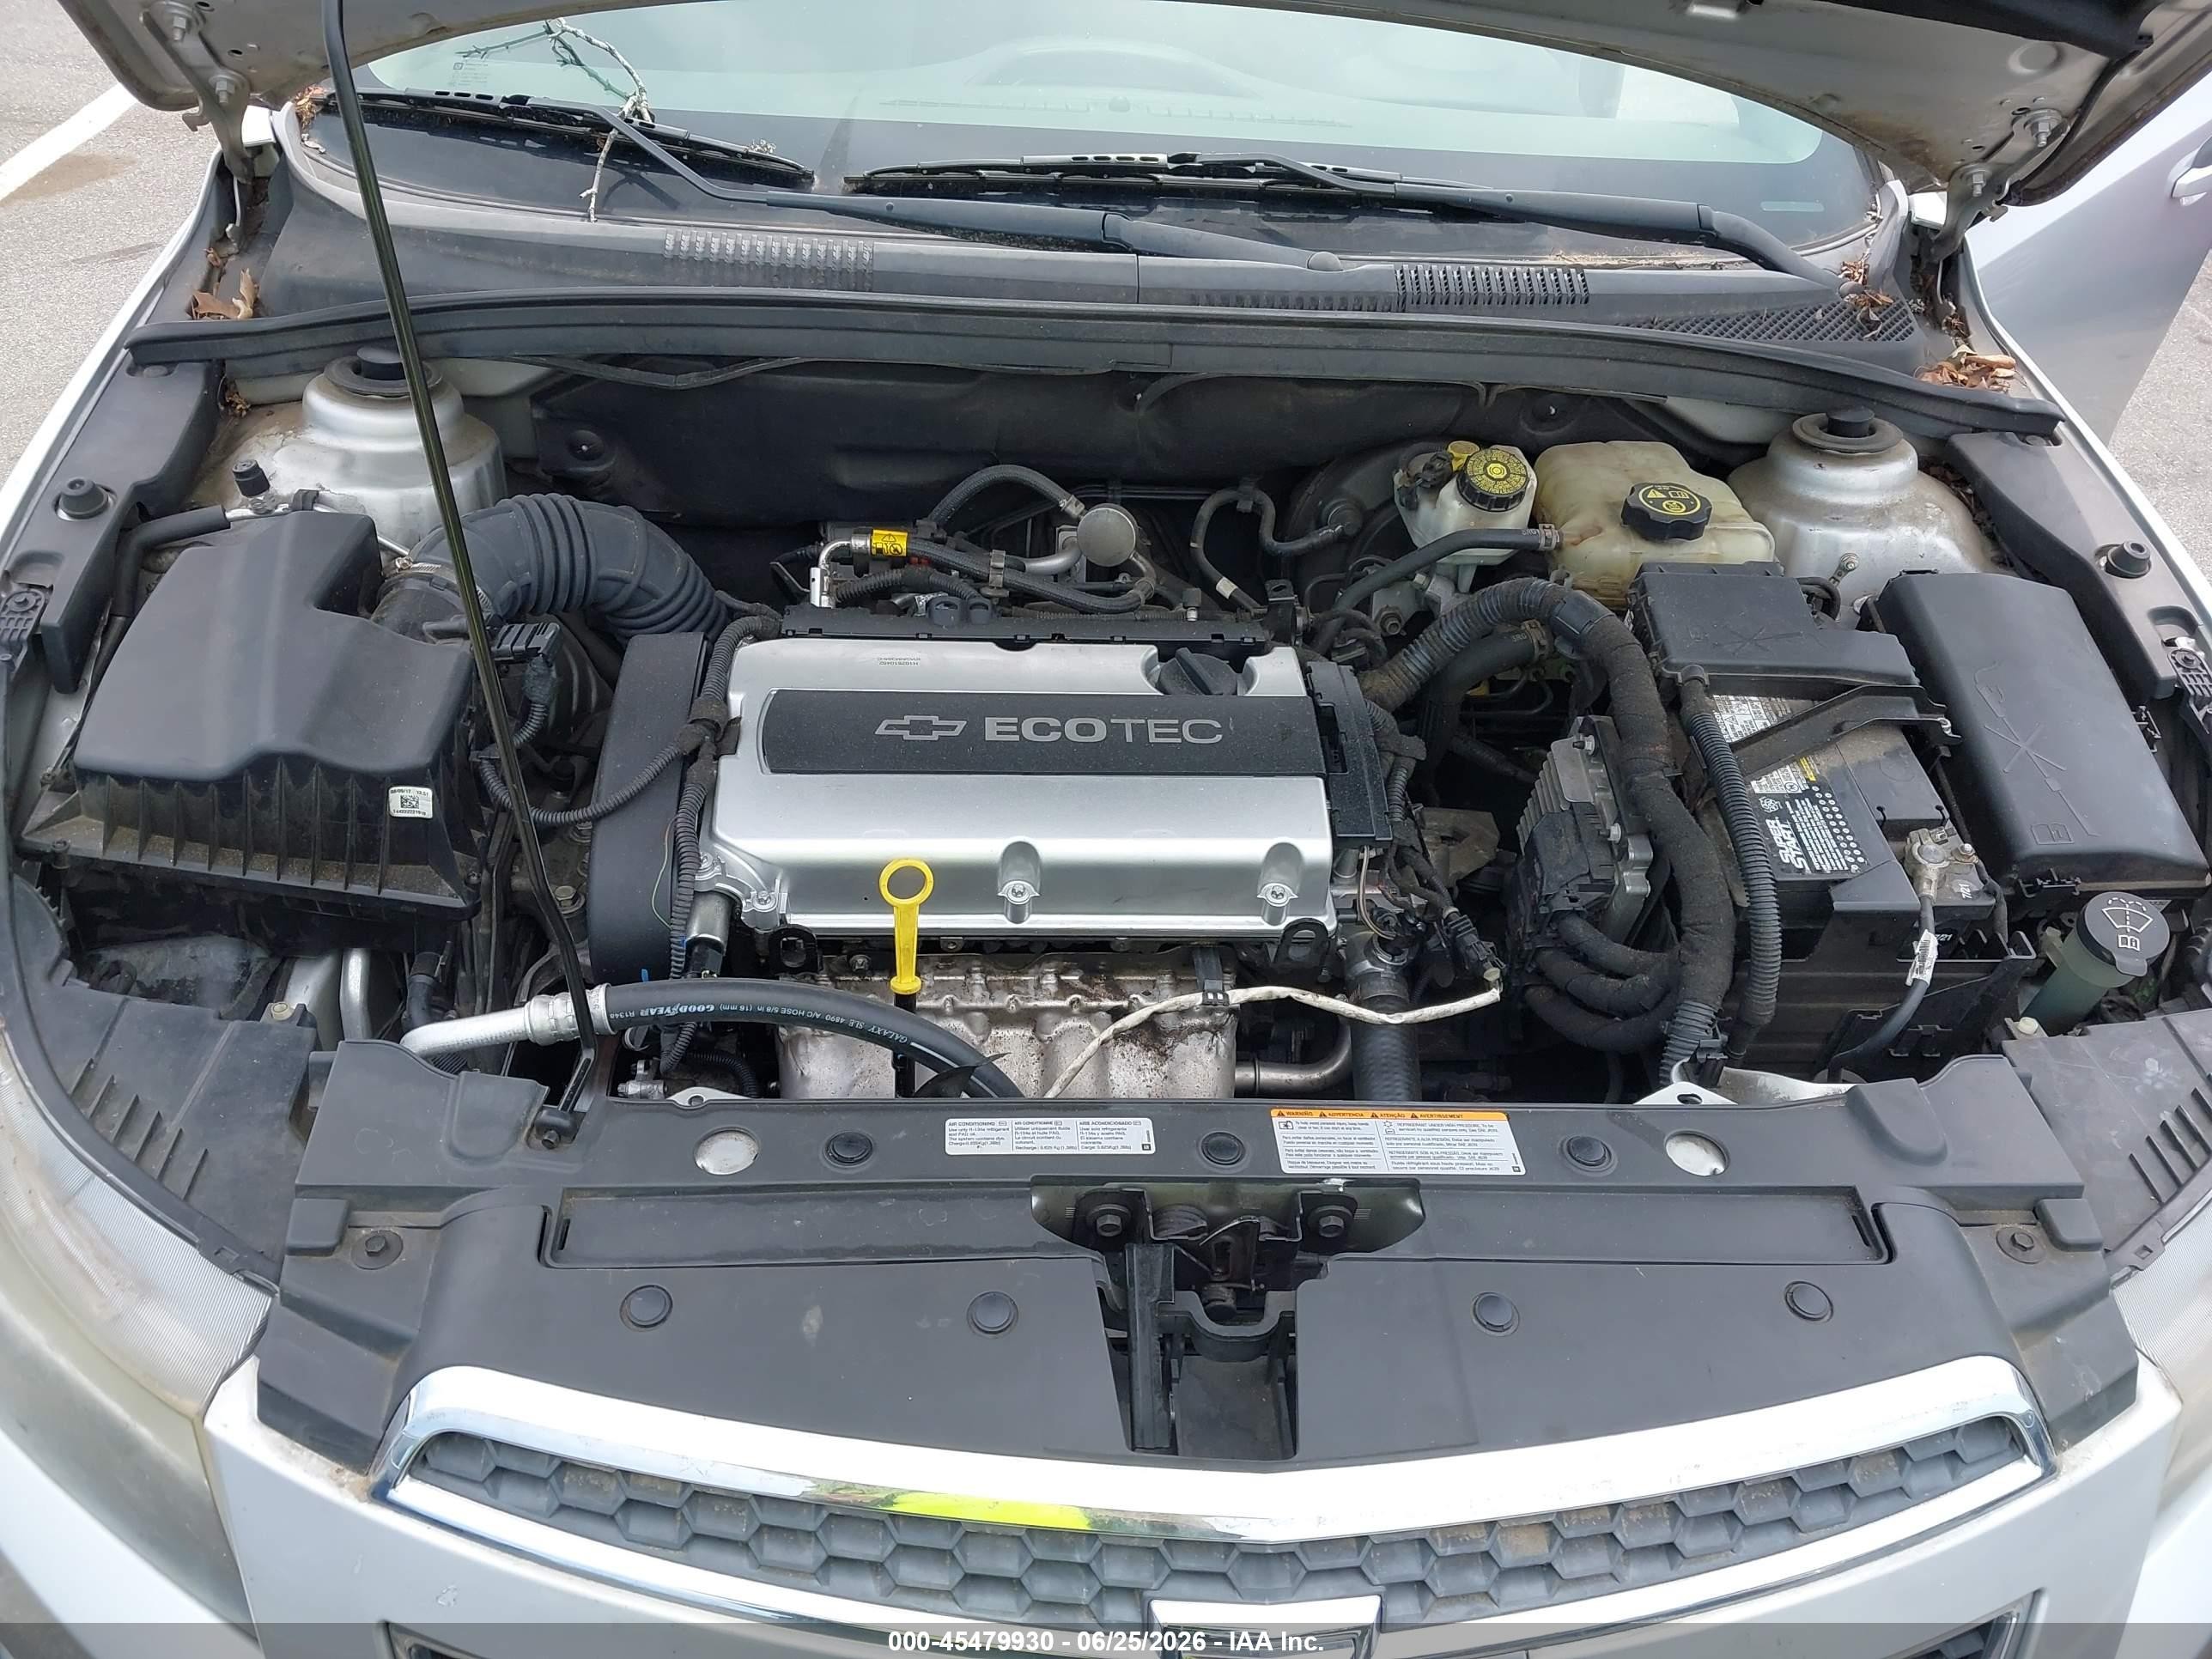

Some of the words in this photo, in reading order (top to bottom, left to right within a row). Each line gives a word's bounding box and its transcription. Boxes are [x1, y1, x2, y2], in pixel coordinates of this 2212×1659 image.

[985, 716, 1224, 744] ECOTEC
[1765, 818, 1791, 864] SUPER
[1777, 820, 1808, 871] START
[1958, 883, 1972, 899] 7/21
[640, 1002, 715, 1017] GOODYEAR
[719, 1003, 739, 1012] mm)
[766, 1006, 780, 1014] 5/8
[781, 1007, 805, 1017] HOSE
[806, 1010, 822, 1019] A/C
[825, 1014, 846, 1024] 4890
[848, 1018, 866, 1030] SLE
[867, 1025, 908, 1044] GALAXY
